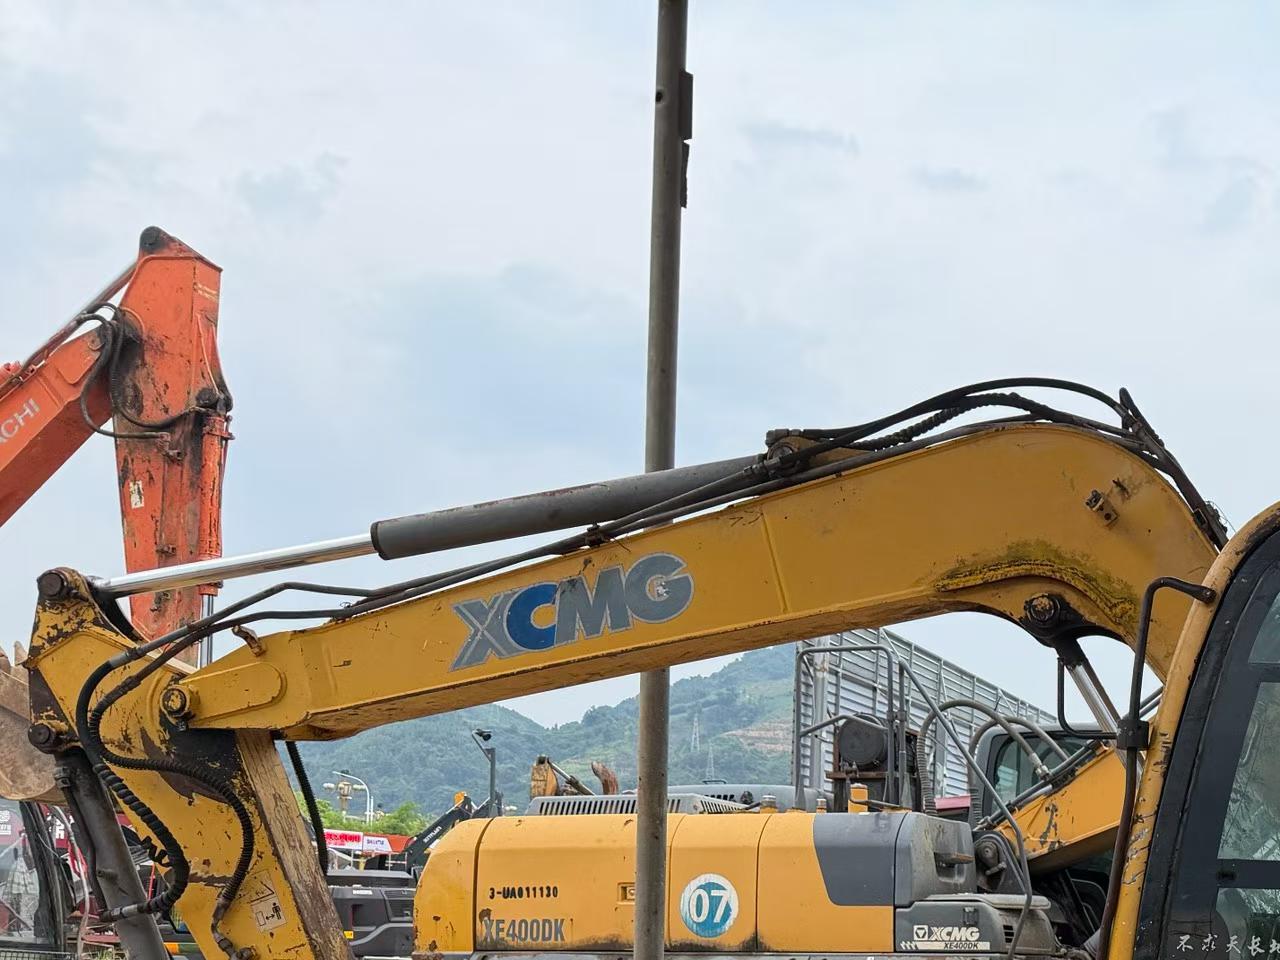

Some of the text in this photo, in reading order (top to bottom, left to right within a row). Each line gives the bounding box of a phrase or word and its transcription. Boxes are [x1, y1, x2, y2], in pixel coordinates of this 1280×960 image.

[449, 552, 694, 672] XCMG
[690, 888, 731, 924] 07
[482, 918, 566, 944] XE400DK
[929, 926, 980, 941] XCMG
[944, 942, 979, 950] XE400DK
